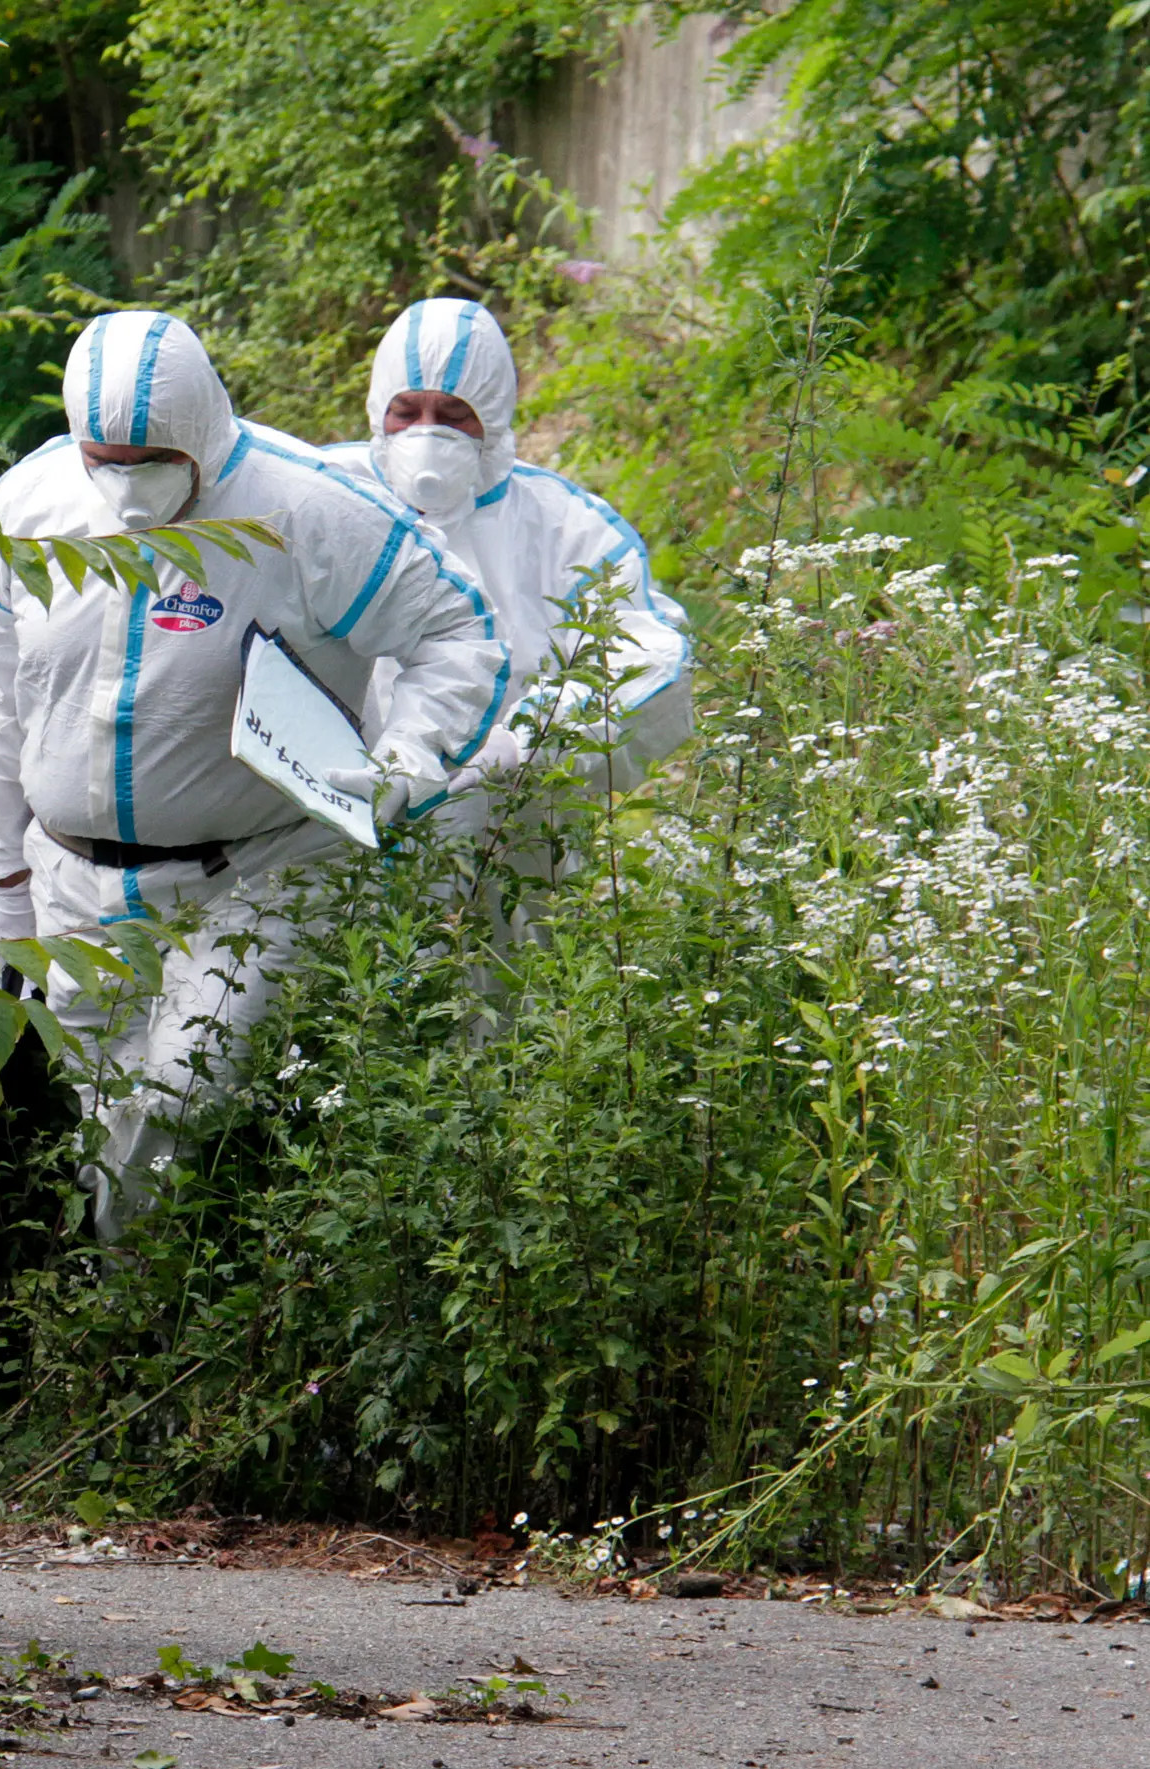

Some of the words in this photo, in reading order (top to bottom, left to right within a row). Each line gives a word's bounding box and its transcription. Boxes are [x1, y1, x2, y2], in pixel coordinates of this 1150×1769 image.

[164, 598, 221, 618] ChemFor
[179, 619, 199, 629] plus
[246, 708, 272, 747] PR
